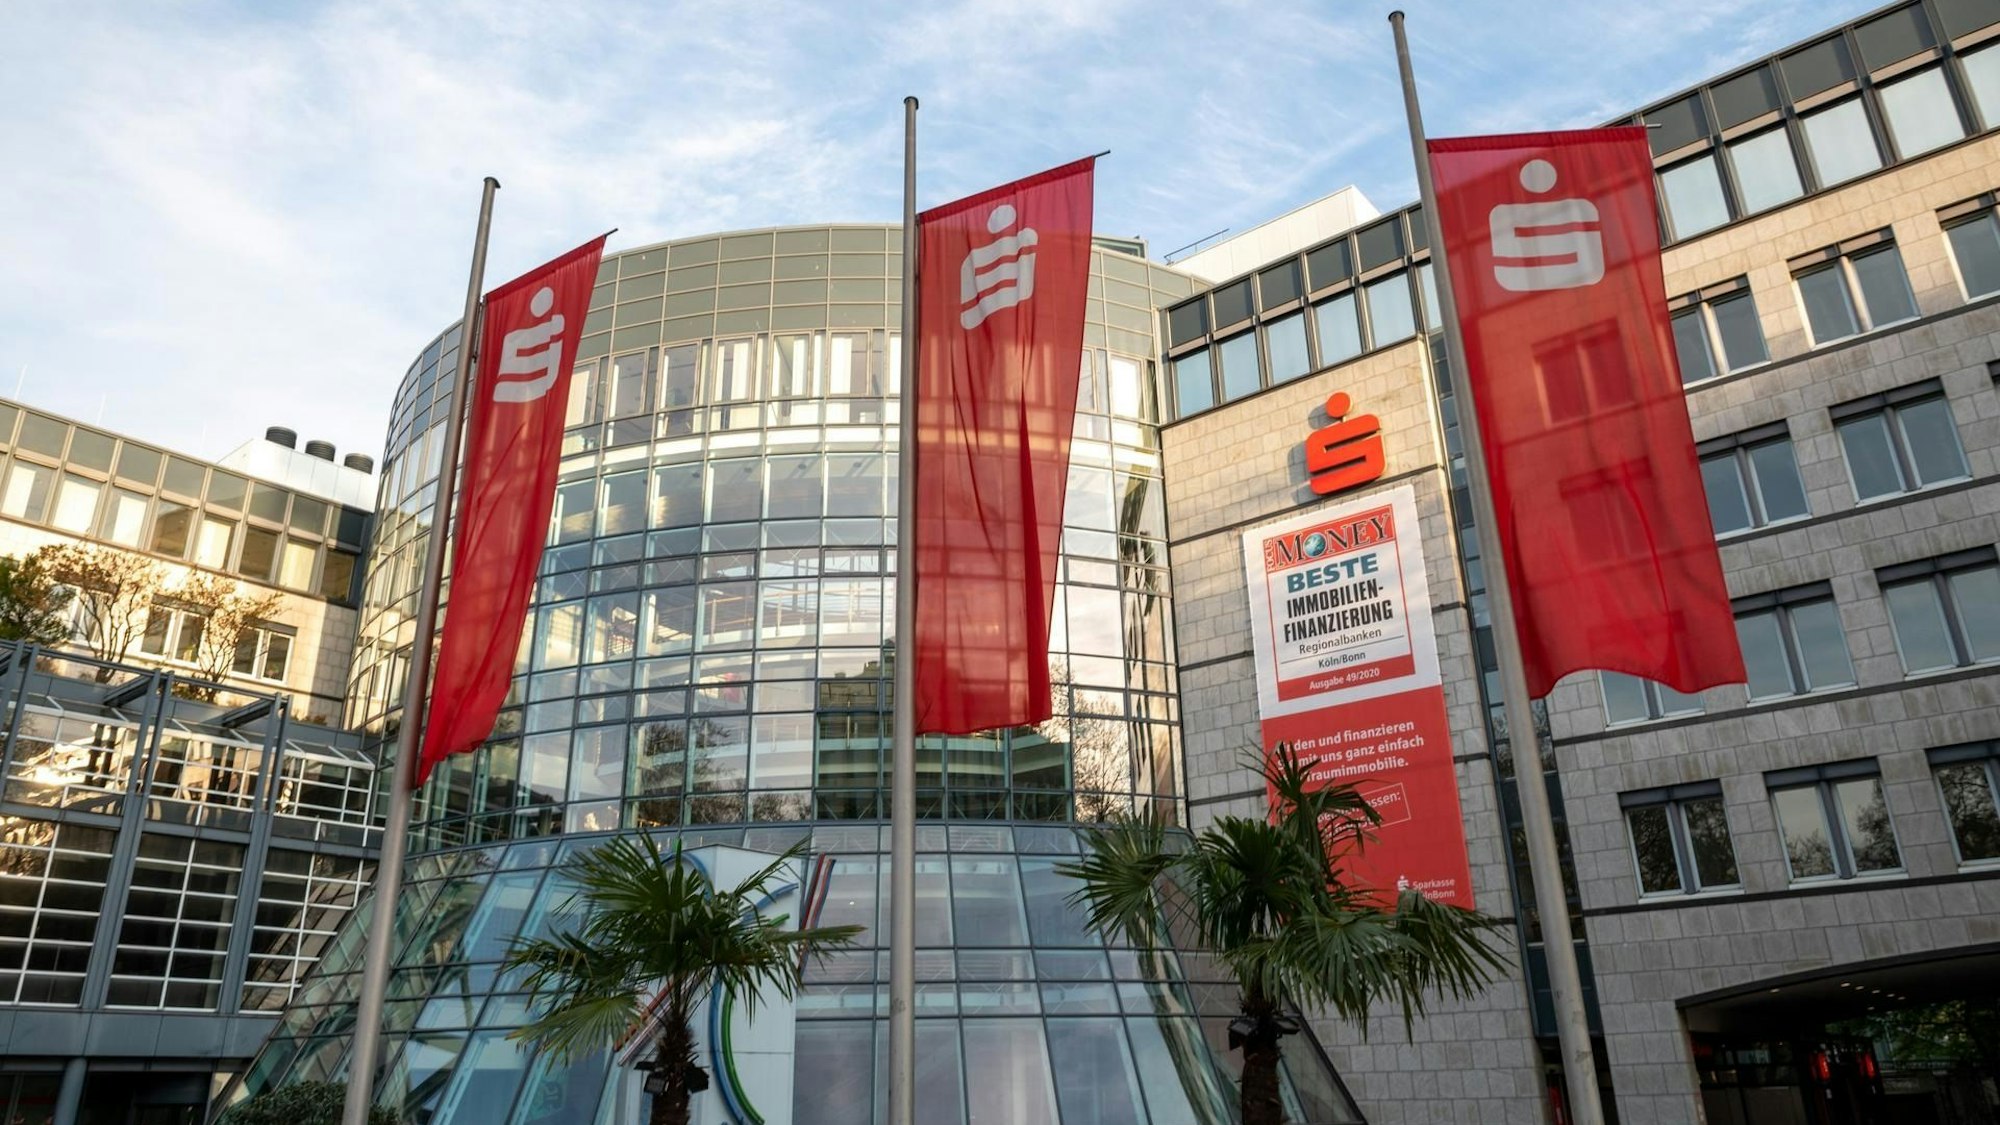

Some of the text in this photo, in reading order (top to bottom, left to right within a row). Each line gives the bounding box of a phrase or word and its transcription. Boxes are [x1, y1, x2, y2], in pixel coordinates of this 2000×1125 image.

[1287, 553, 1379, 593] BESTE
[1287, 578, 1384, 619] IMMOBILIEN-
[1284, 599, 1394, 643] FINANZIERUNG
[1299, 628, 1382, 654] Regionalbanken
[1319, 652, 1366, 669] Köln/Bonn
[1309, 667, 1380, 690] Ausgabe 49/2020
[1318, 732, 1342, 746] und
[1343, 721, 1415, 741] finanzieren
[1320, 751, 1343, 763] uns
[1345, 746, 1376, 761] ganz
[1378, 735, 1424, 752] einfach
[1413, 879, 1456, 891] Sparkasse
